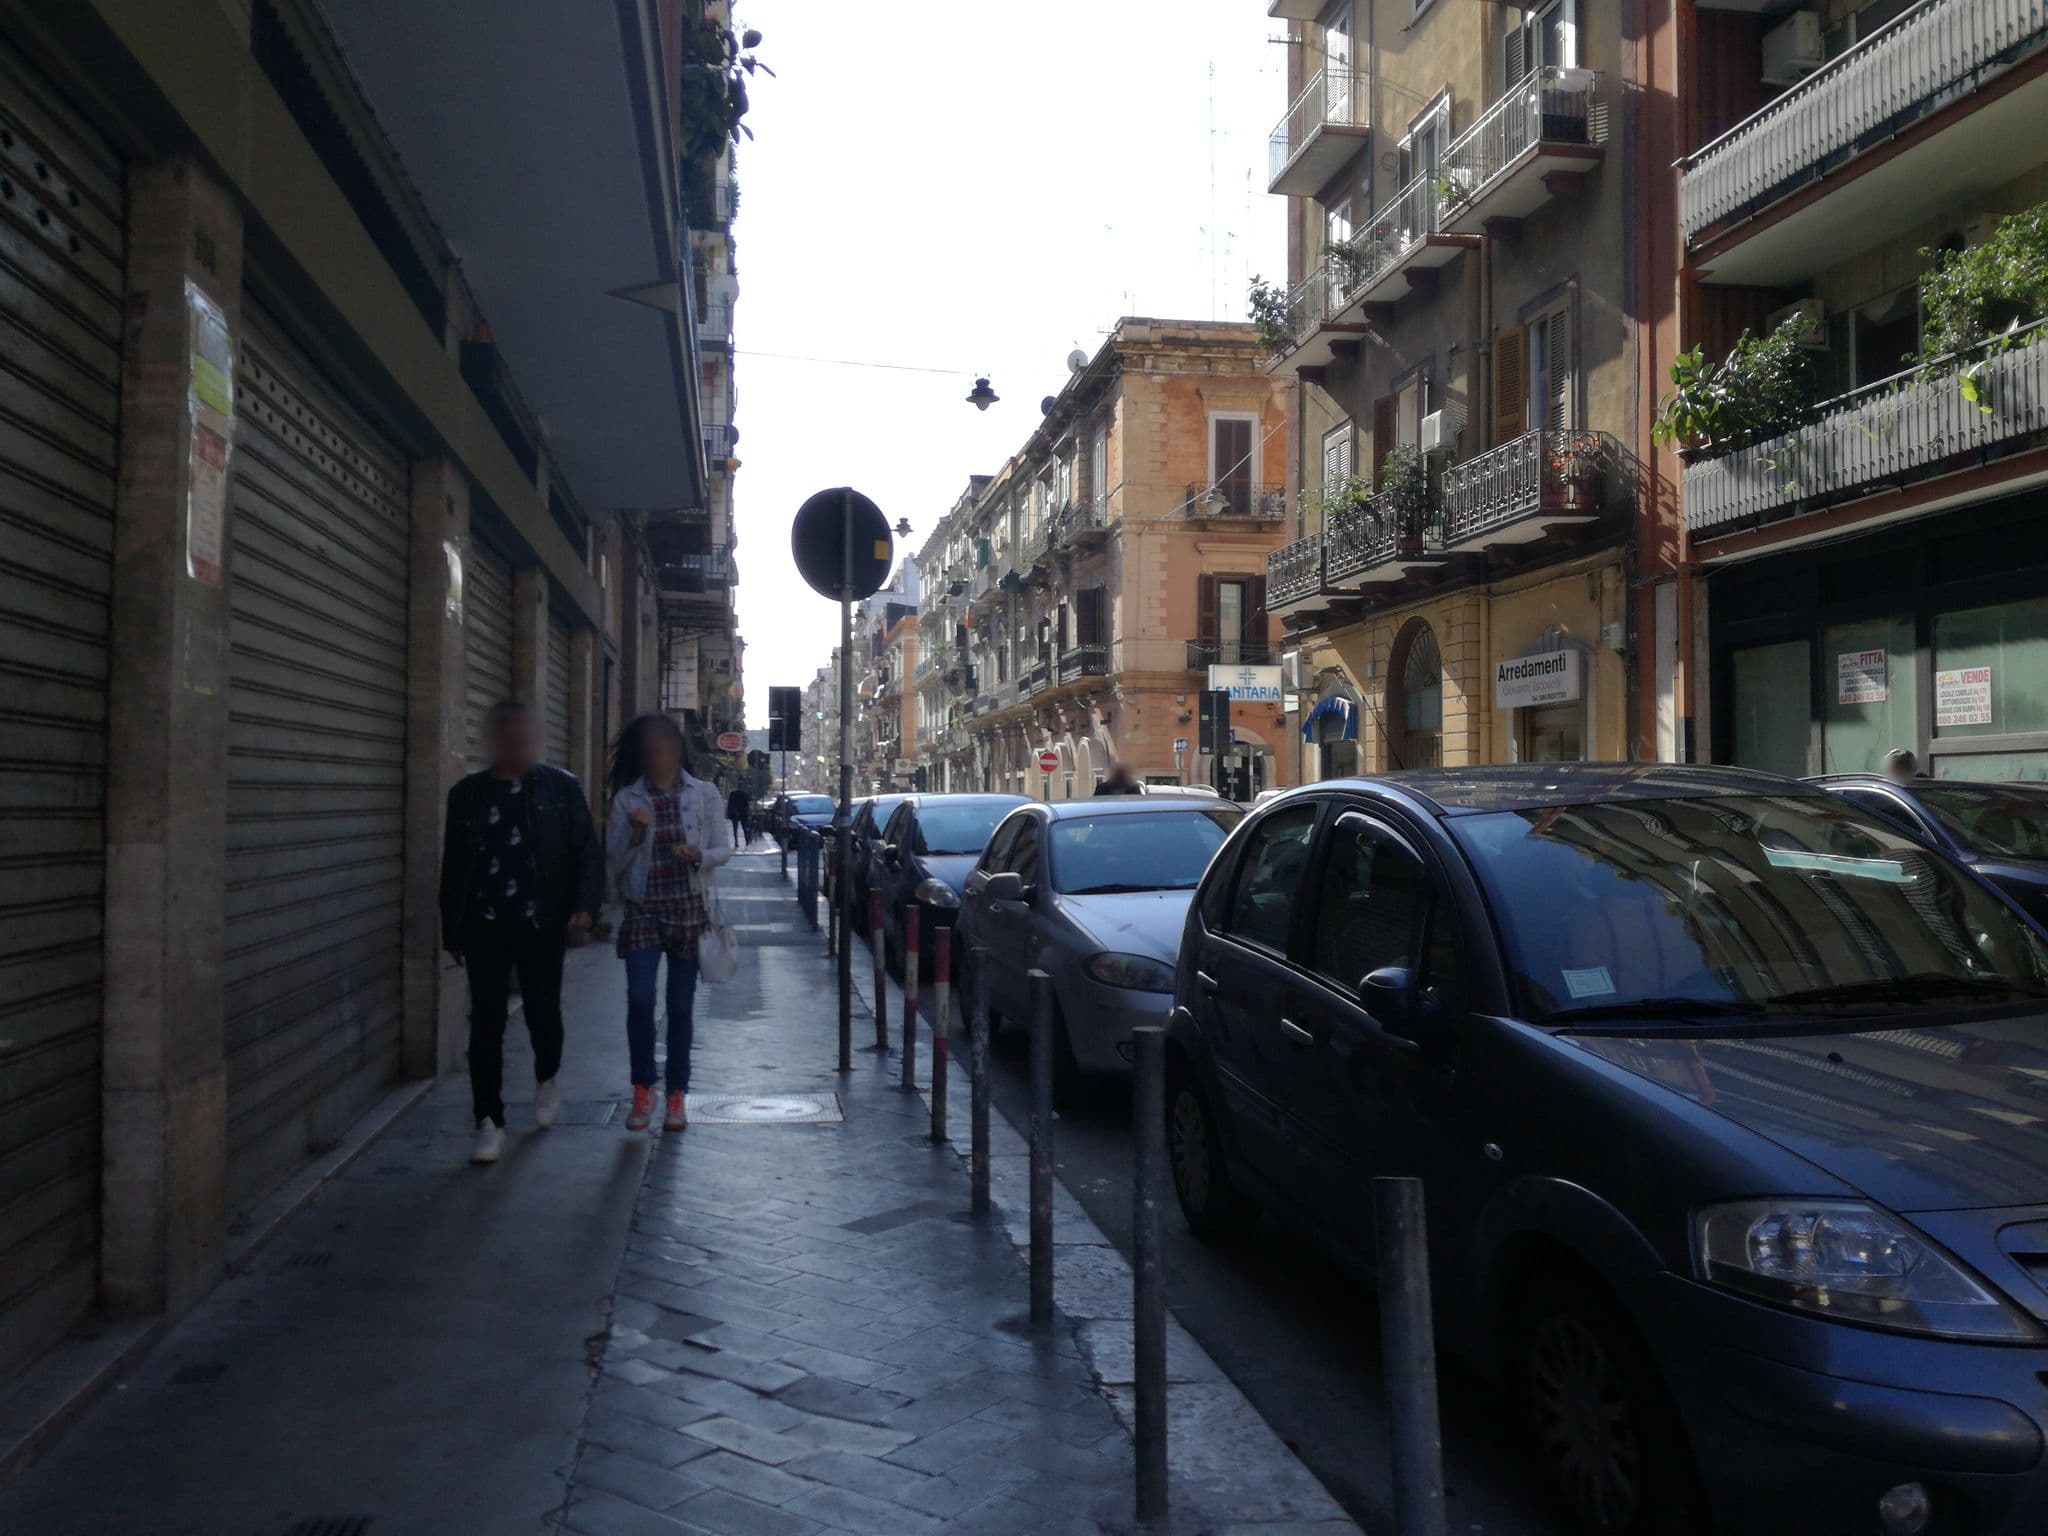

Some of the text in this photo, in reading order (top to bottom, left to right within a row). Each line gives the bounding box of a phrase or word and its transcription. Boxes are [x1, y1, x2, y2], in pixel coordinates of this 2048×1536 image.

[1860, 651, 1884, 665] FITTA
[1498, 653, 1566, 682] Arredamenti
[1960, 669, 1989, 684] VENDE
[1938, 712, 1990, 724] 080 246 02 55
